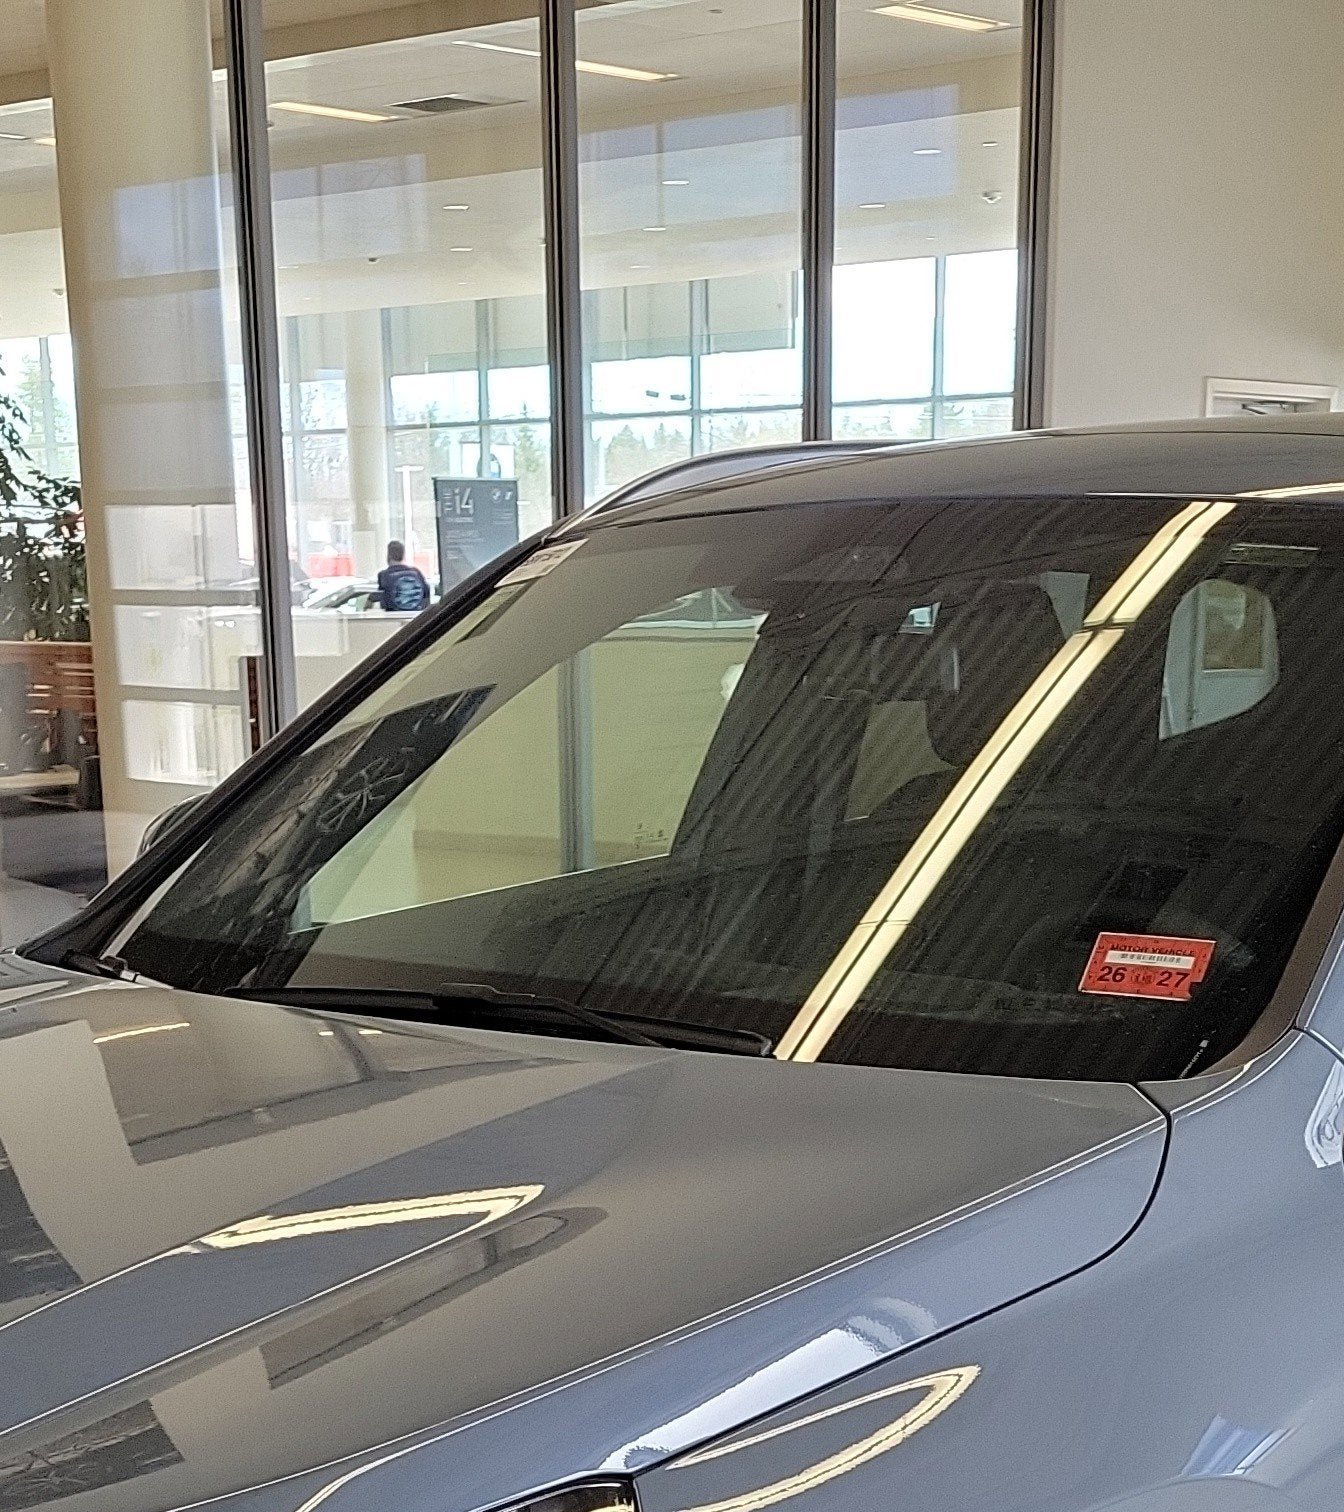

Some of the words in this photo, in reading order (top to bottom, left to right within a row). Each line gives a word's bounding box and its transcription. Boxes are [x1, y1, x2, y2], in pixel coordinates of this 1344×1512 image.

[454, 488, 475, 515] i4
[1096, 965, 1128, 983] 26
[1155, 970, 1191, 988] 27
